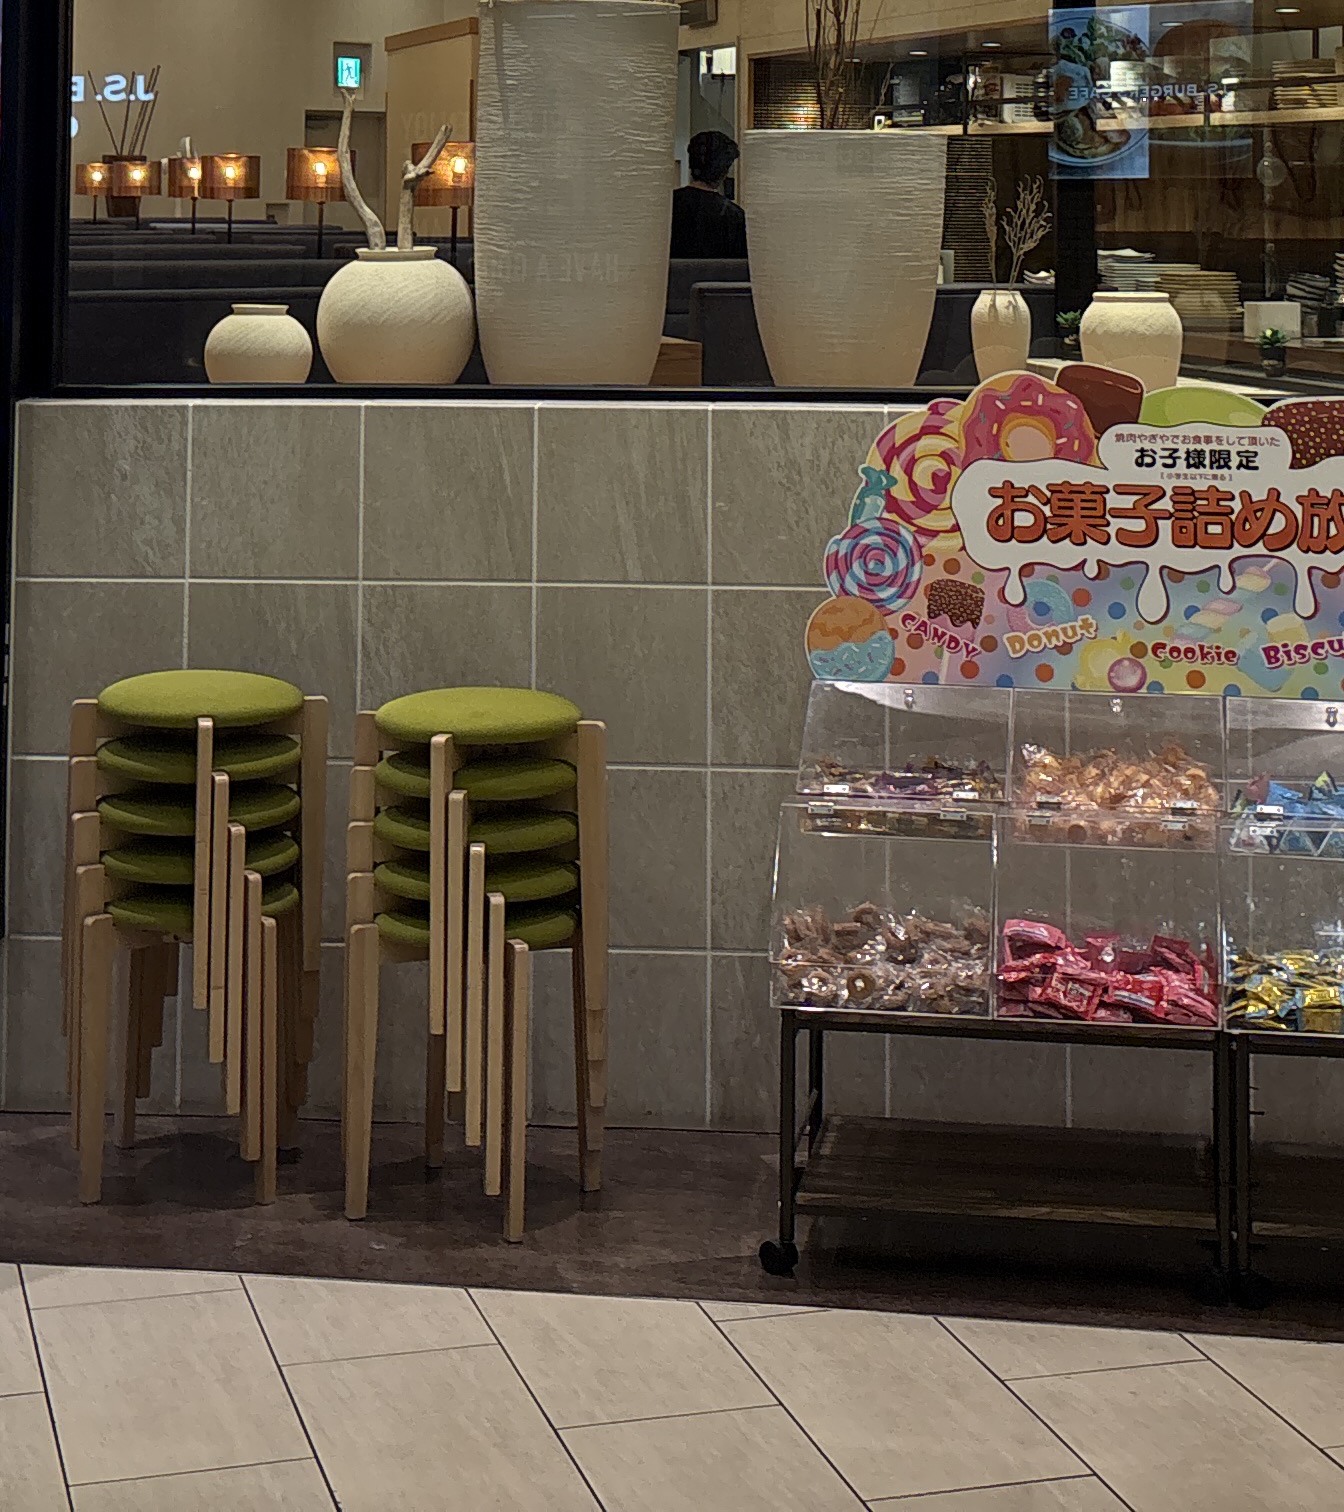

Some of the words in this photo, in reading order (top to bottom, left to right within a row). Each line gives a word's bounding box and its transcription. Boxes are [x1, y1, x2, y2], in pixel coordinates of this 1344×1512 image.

[1134, 446, 1260, 471] お子様限定
[898, 610, 981, 660] CANDY
[1006, 616, 1097, 656] Donut
[1150, 642, 1239, 667] Cookie
